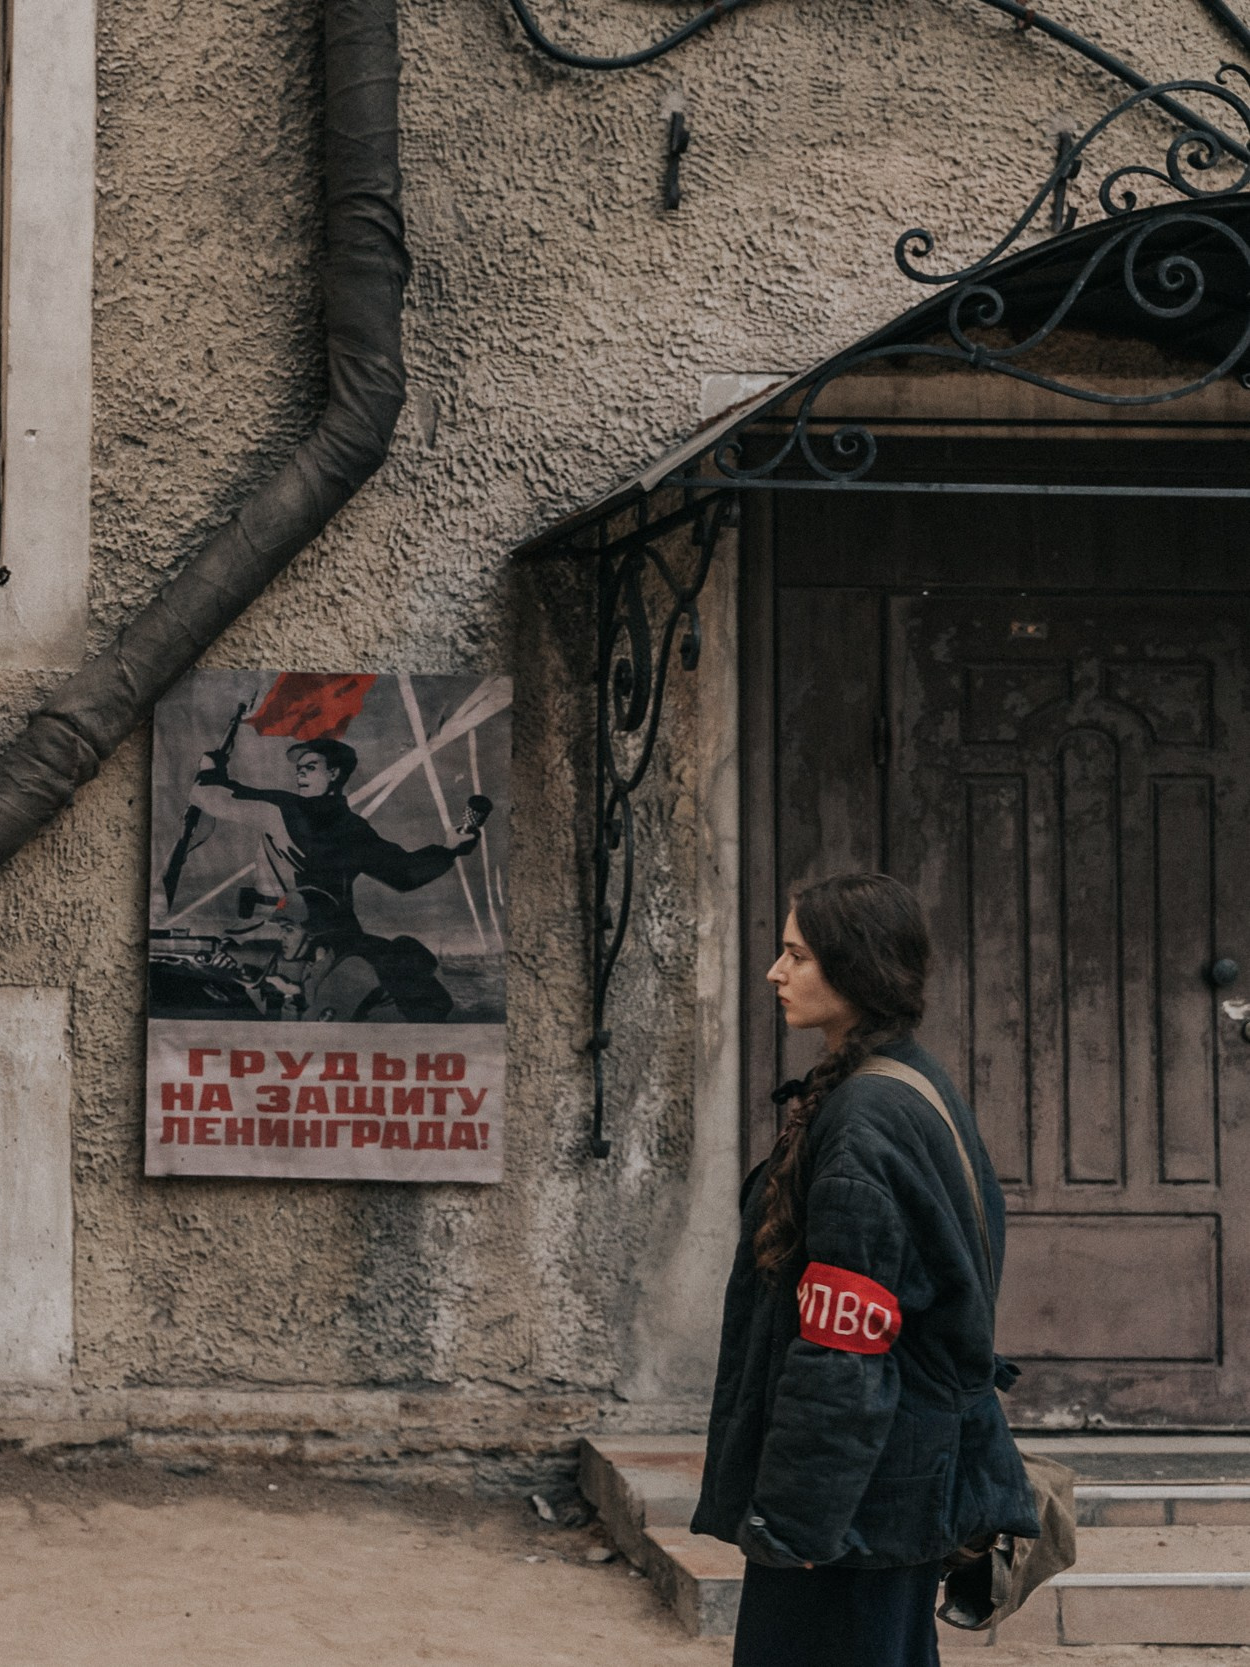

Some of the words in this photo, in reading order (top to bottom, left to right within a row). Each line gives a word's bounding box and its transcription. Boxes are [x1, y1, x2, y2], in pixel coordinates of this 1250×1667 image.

[187, 1048, 467, 1082] ГРУДЬЮ
[160, 1083, 234, 1112] НА
[255, 1085, 488, 1116] ЗАЩИТУ
[159, 1116, 490, 1150] ЛЕНИНГРАДА!
